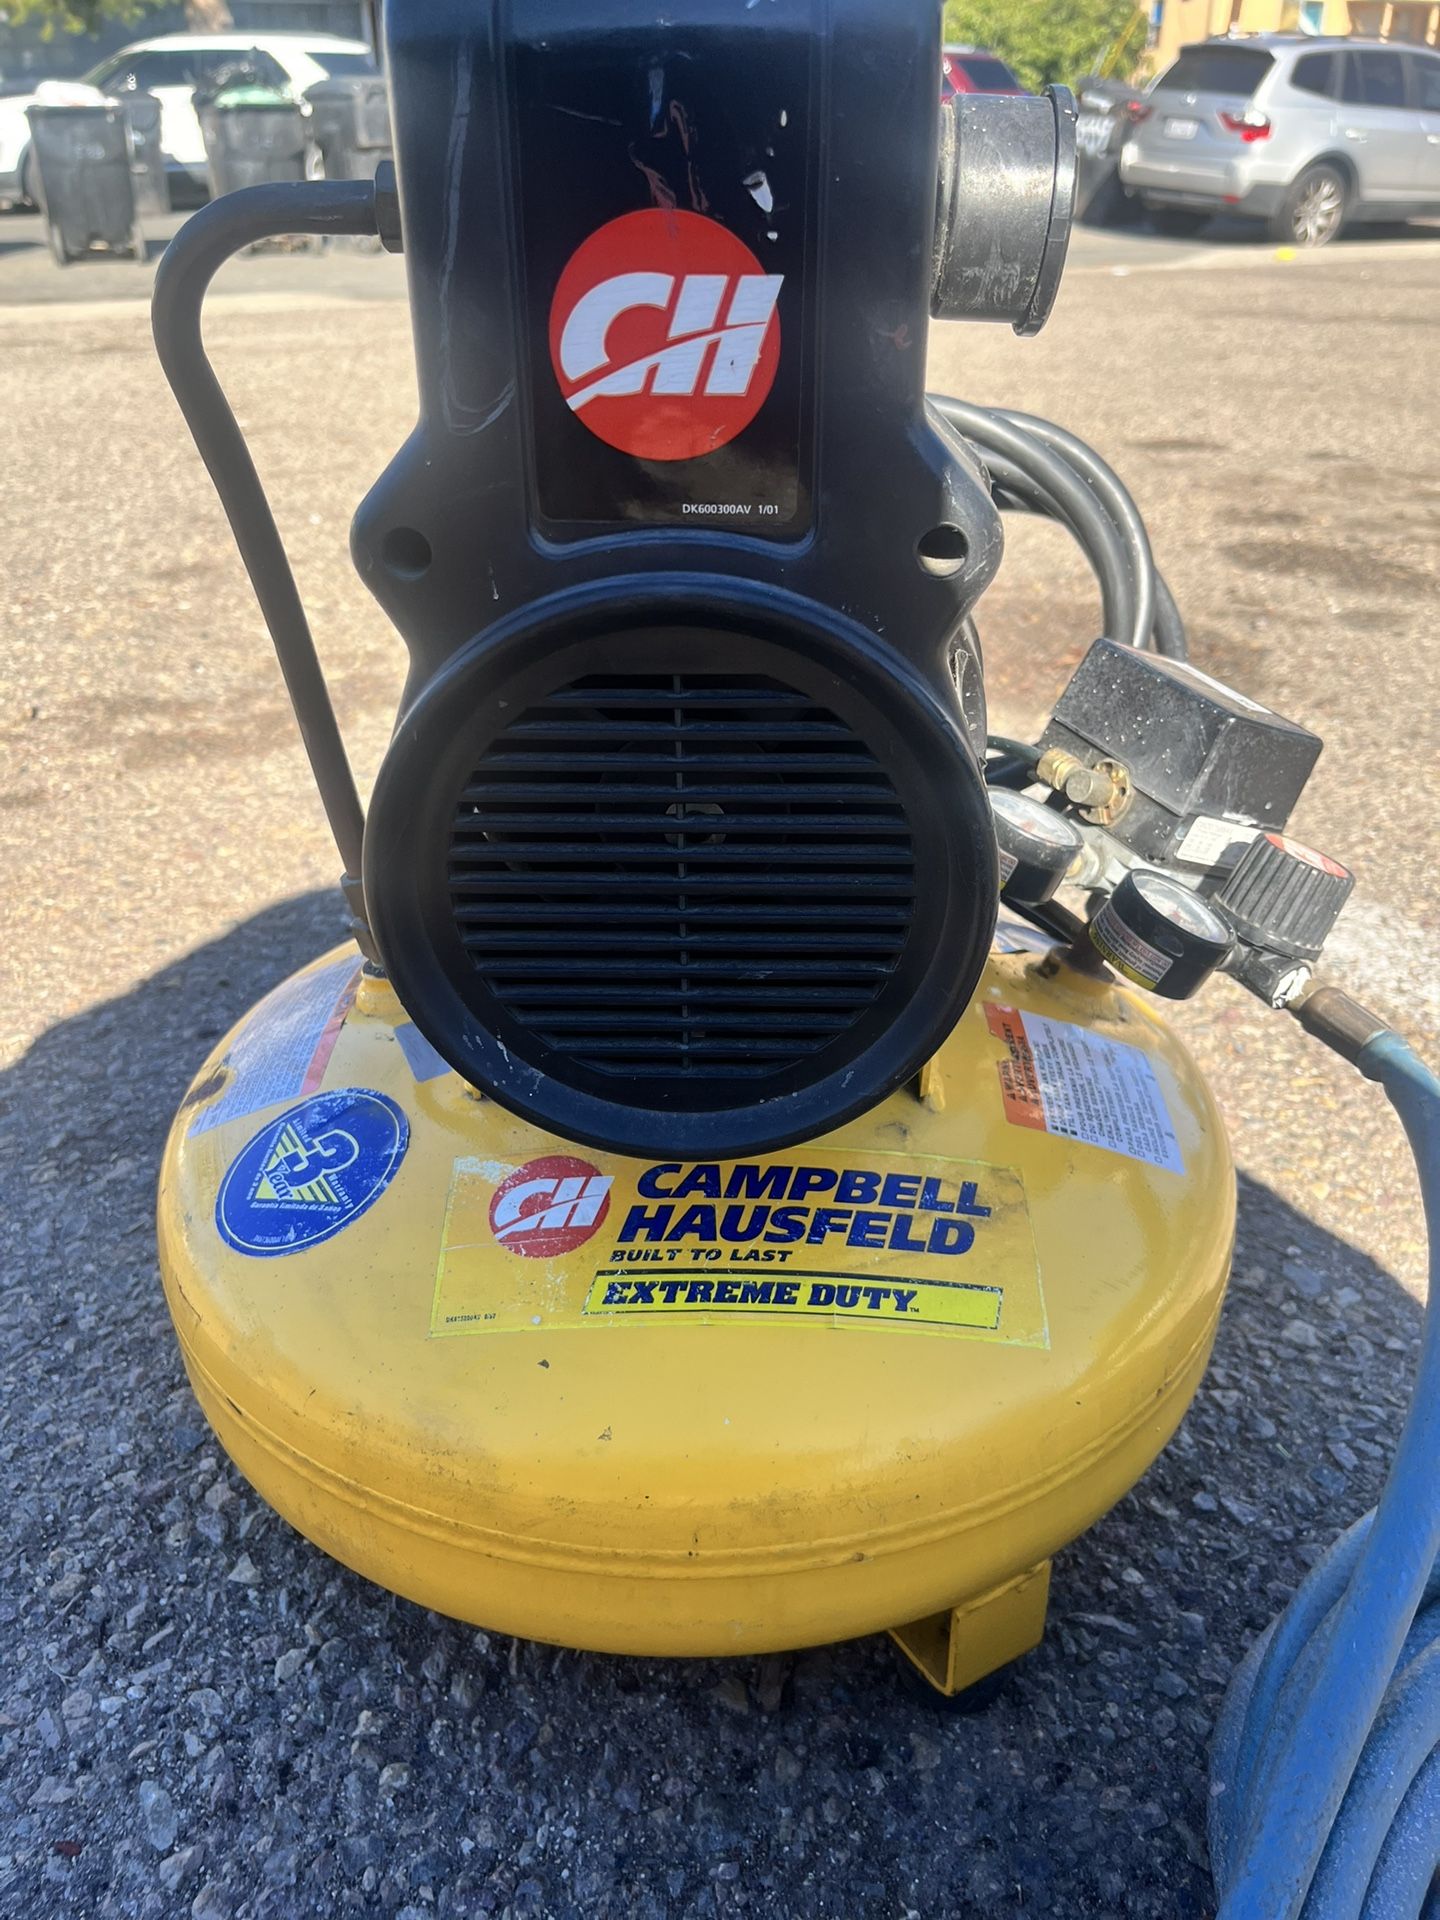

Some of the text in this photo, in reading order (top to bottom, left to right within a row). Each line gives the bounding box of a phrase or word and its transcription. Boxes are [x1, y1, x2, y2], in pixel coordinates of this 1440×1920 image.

[682, 503, 779, 515] DK600300AV 1/01
[262, 1156, 295, 1202] Year
[279, 1129, 360, 1189] 3
[637, 1163, 992, 1217] CAMPBELL
[616, 1204, 976, 1255] HAUSFELD
[609, 1248, 794, 1262] BUILT TO LAST
[602, 1280, 801, 1305] EXTREME
